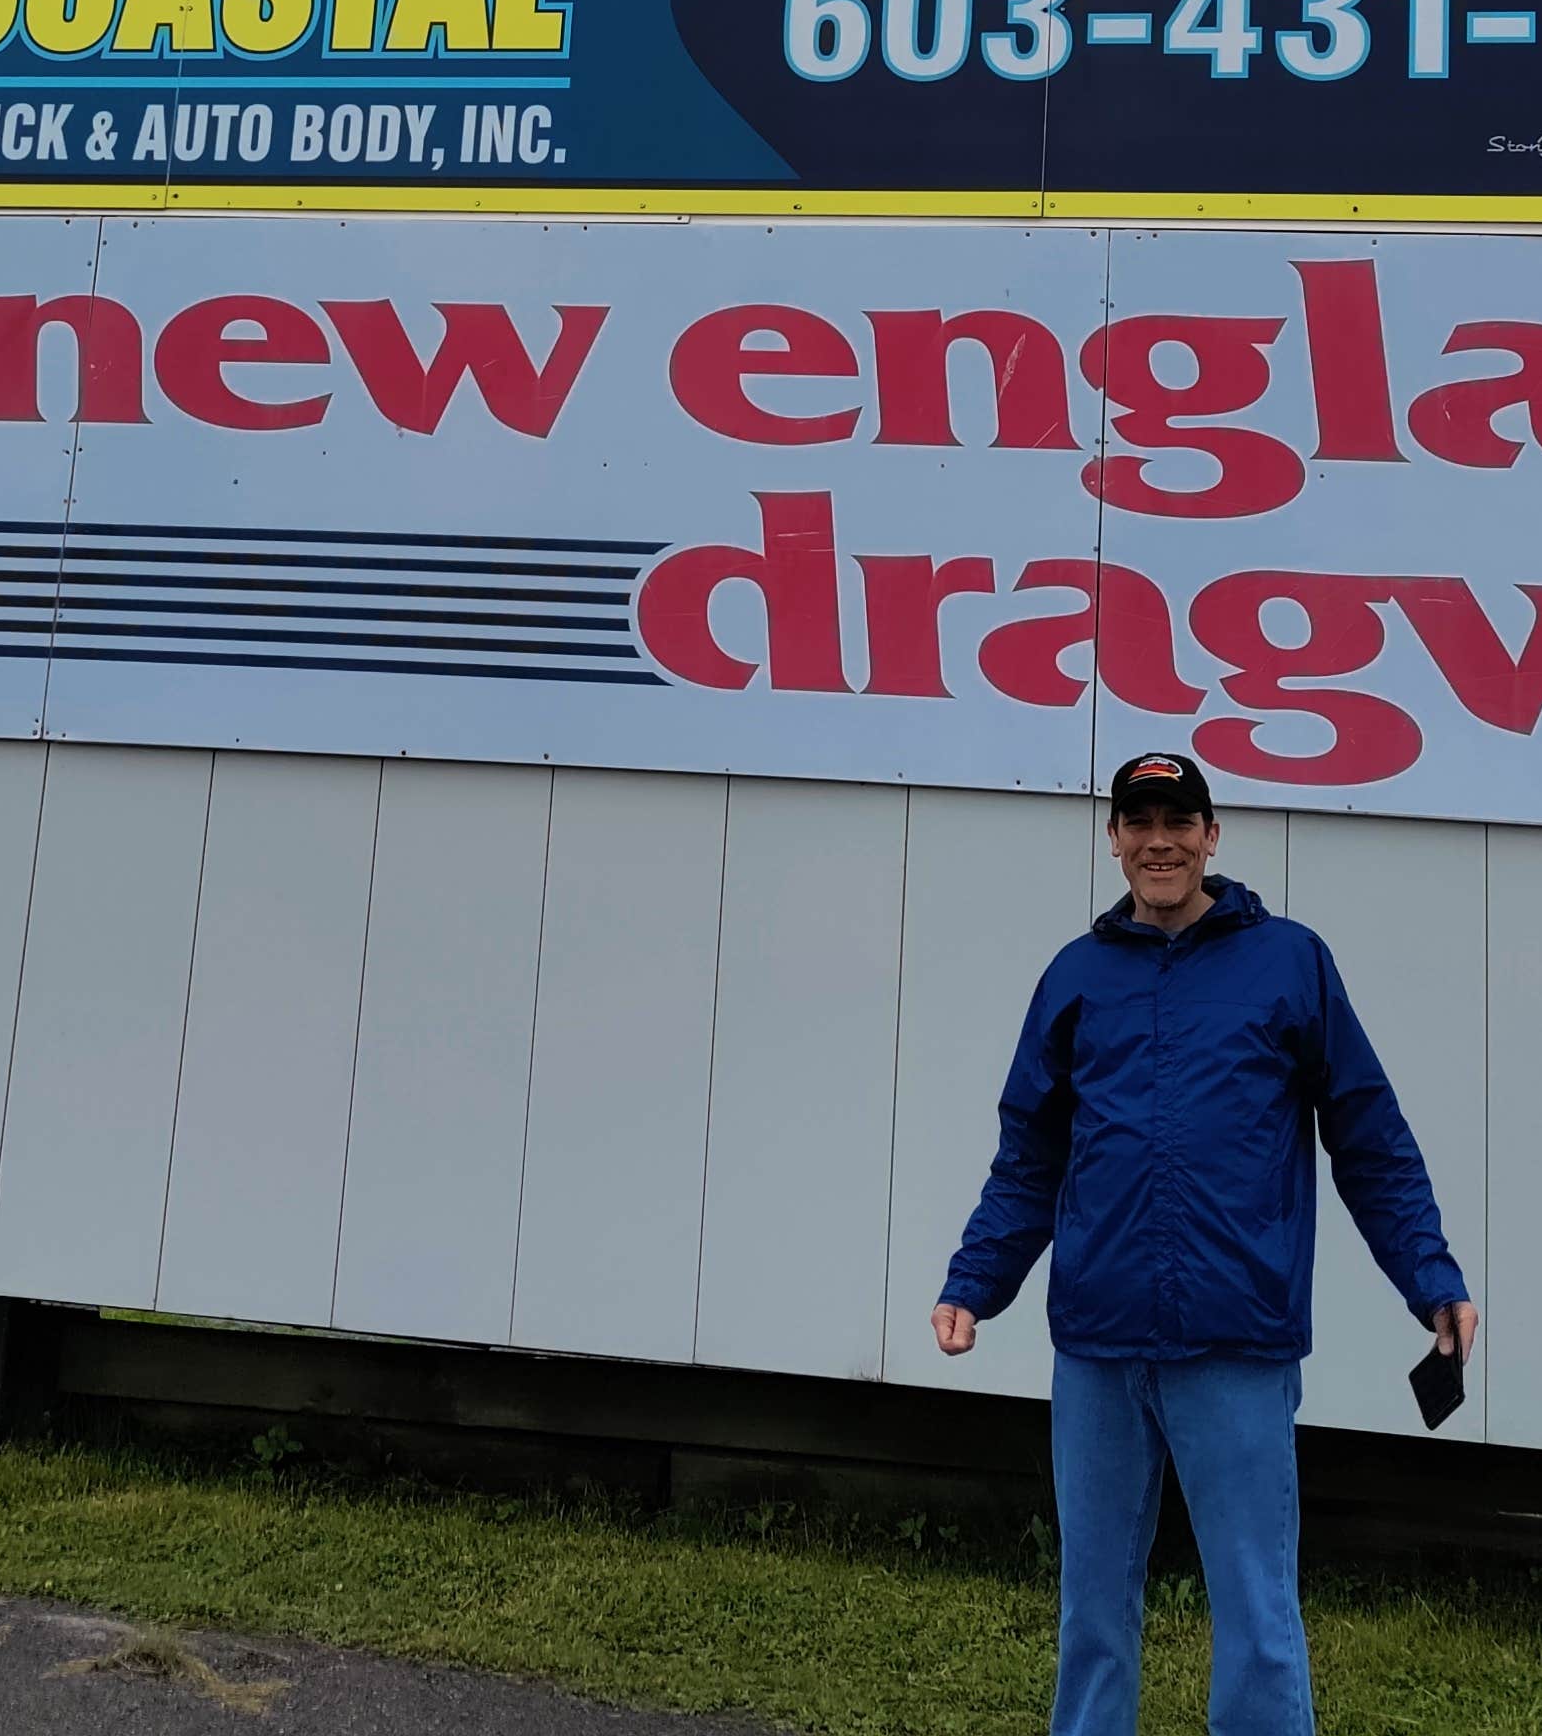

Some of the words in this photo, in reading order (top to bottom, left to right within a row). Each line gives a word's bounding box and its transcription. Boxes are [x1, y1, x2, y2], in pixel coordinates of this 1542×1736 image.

[85, 107, 117, 160] &
[132, 105, 274, 161] AUTO
[292, 105, 445, 171] BODY,
[460, 106, 568, 164] INC.
